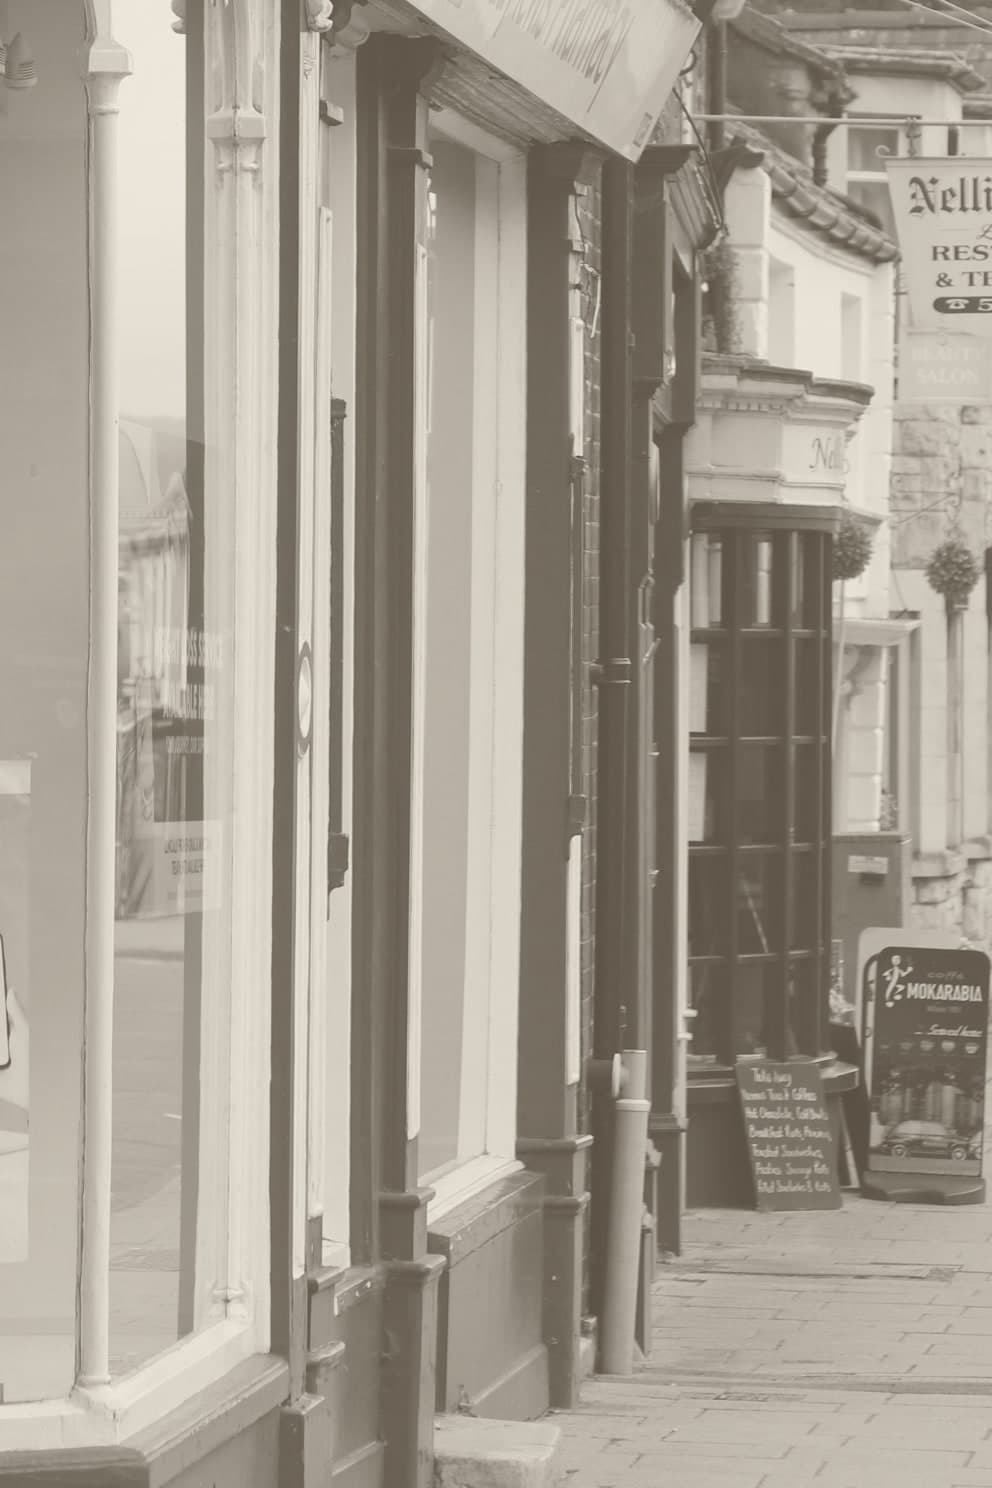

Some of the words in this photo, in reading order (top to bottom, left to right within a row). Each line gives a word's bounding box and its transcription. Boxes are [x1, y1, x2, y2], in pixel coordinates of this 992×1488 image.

[935, 272, 953, 288] &
[916, 368, 978, 385] SALON
[906, 983, 983, 1002] MOKARABIA
